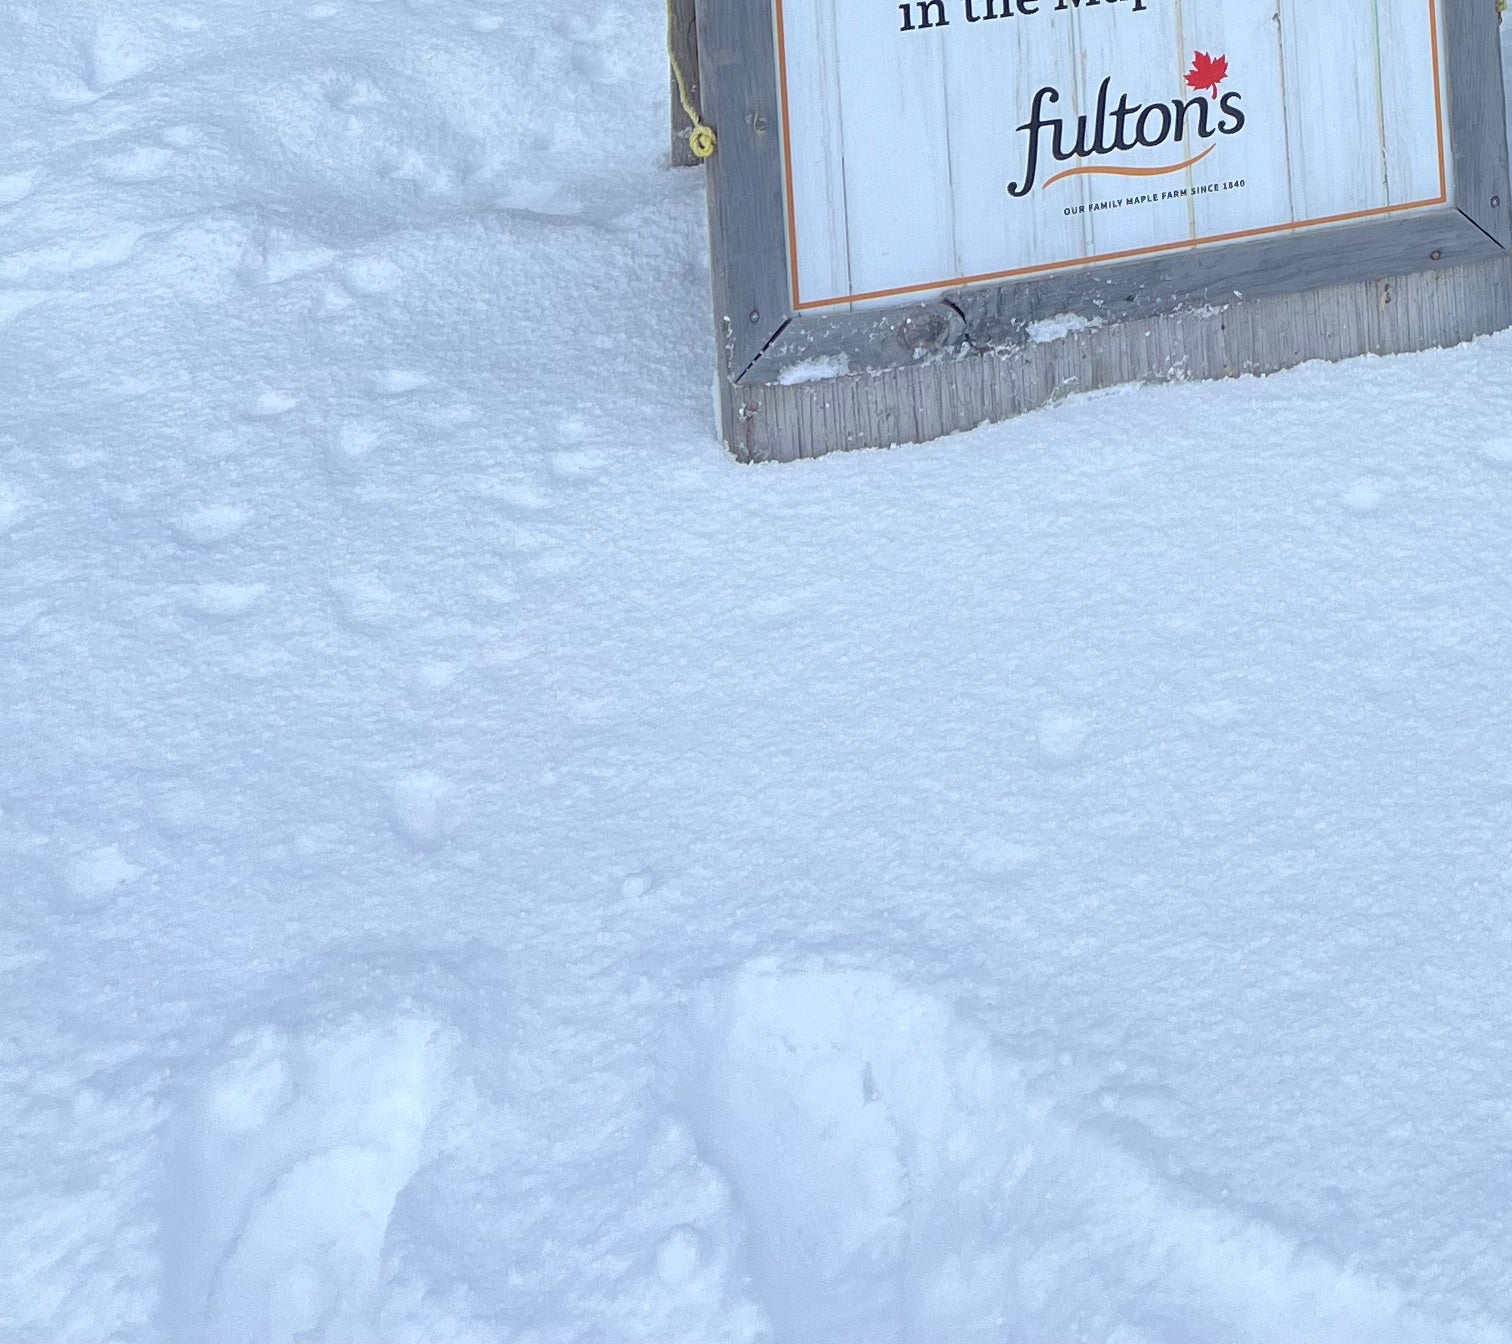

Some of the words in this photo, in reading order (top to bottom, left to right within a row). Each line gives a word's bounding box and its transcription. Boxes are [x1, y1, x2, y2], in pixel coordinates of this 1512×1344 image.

[1063, 205, 1085, 216] OUR
[1088, 199, 1123, 212] FAMILY
[1126, 193, 1159, 206] MAPLE
[1161, 188, 1188, 201] FARM
[1190, 183, 1220, 195] SINCE
[1222, 179, 1246, 191] 1840
